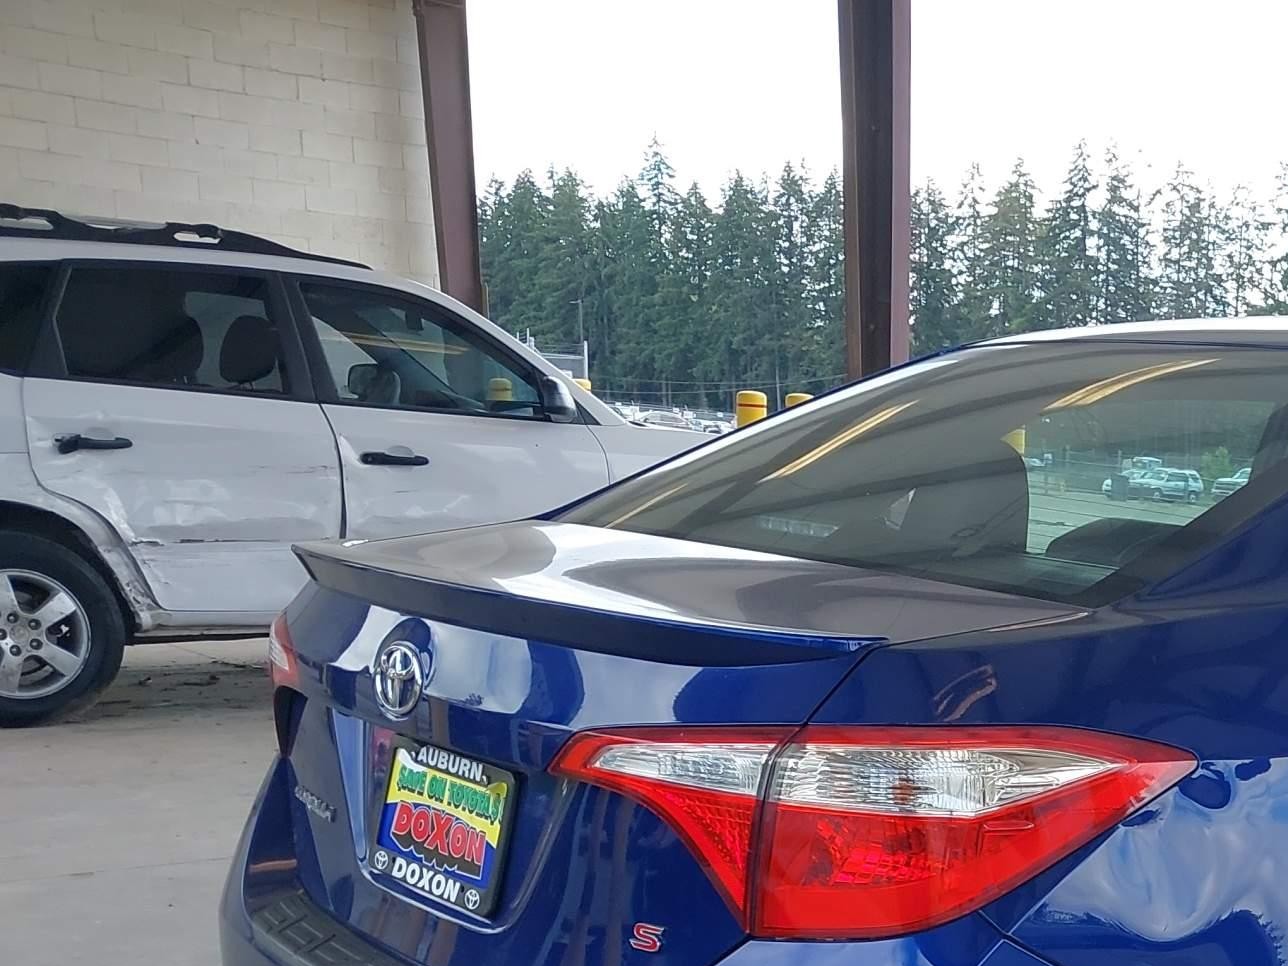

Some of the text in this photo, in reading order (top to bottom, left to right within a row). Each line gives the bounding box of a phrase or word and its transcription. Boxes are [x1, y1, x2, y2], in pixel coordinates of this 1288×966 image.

[417, 747, 483, 781] AUBURN
[427, 774, 448, 802] ON
[393, 802, 486, 865] DOXON
[392, 857, 461, 903] DOXON
[629, 922, 664, 952] S
